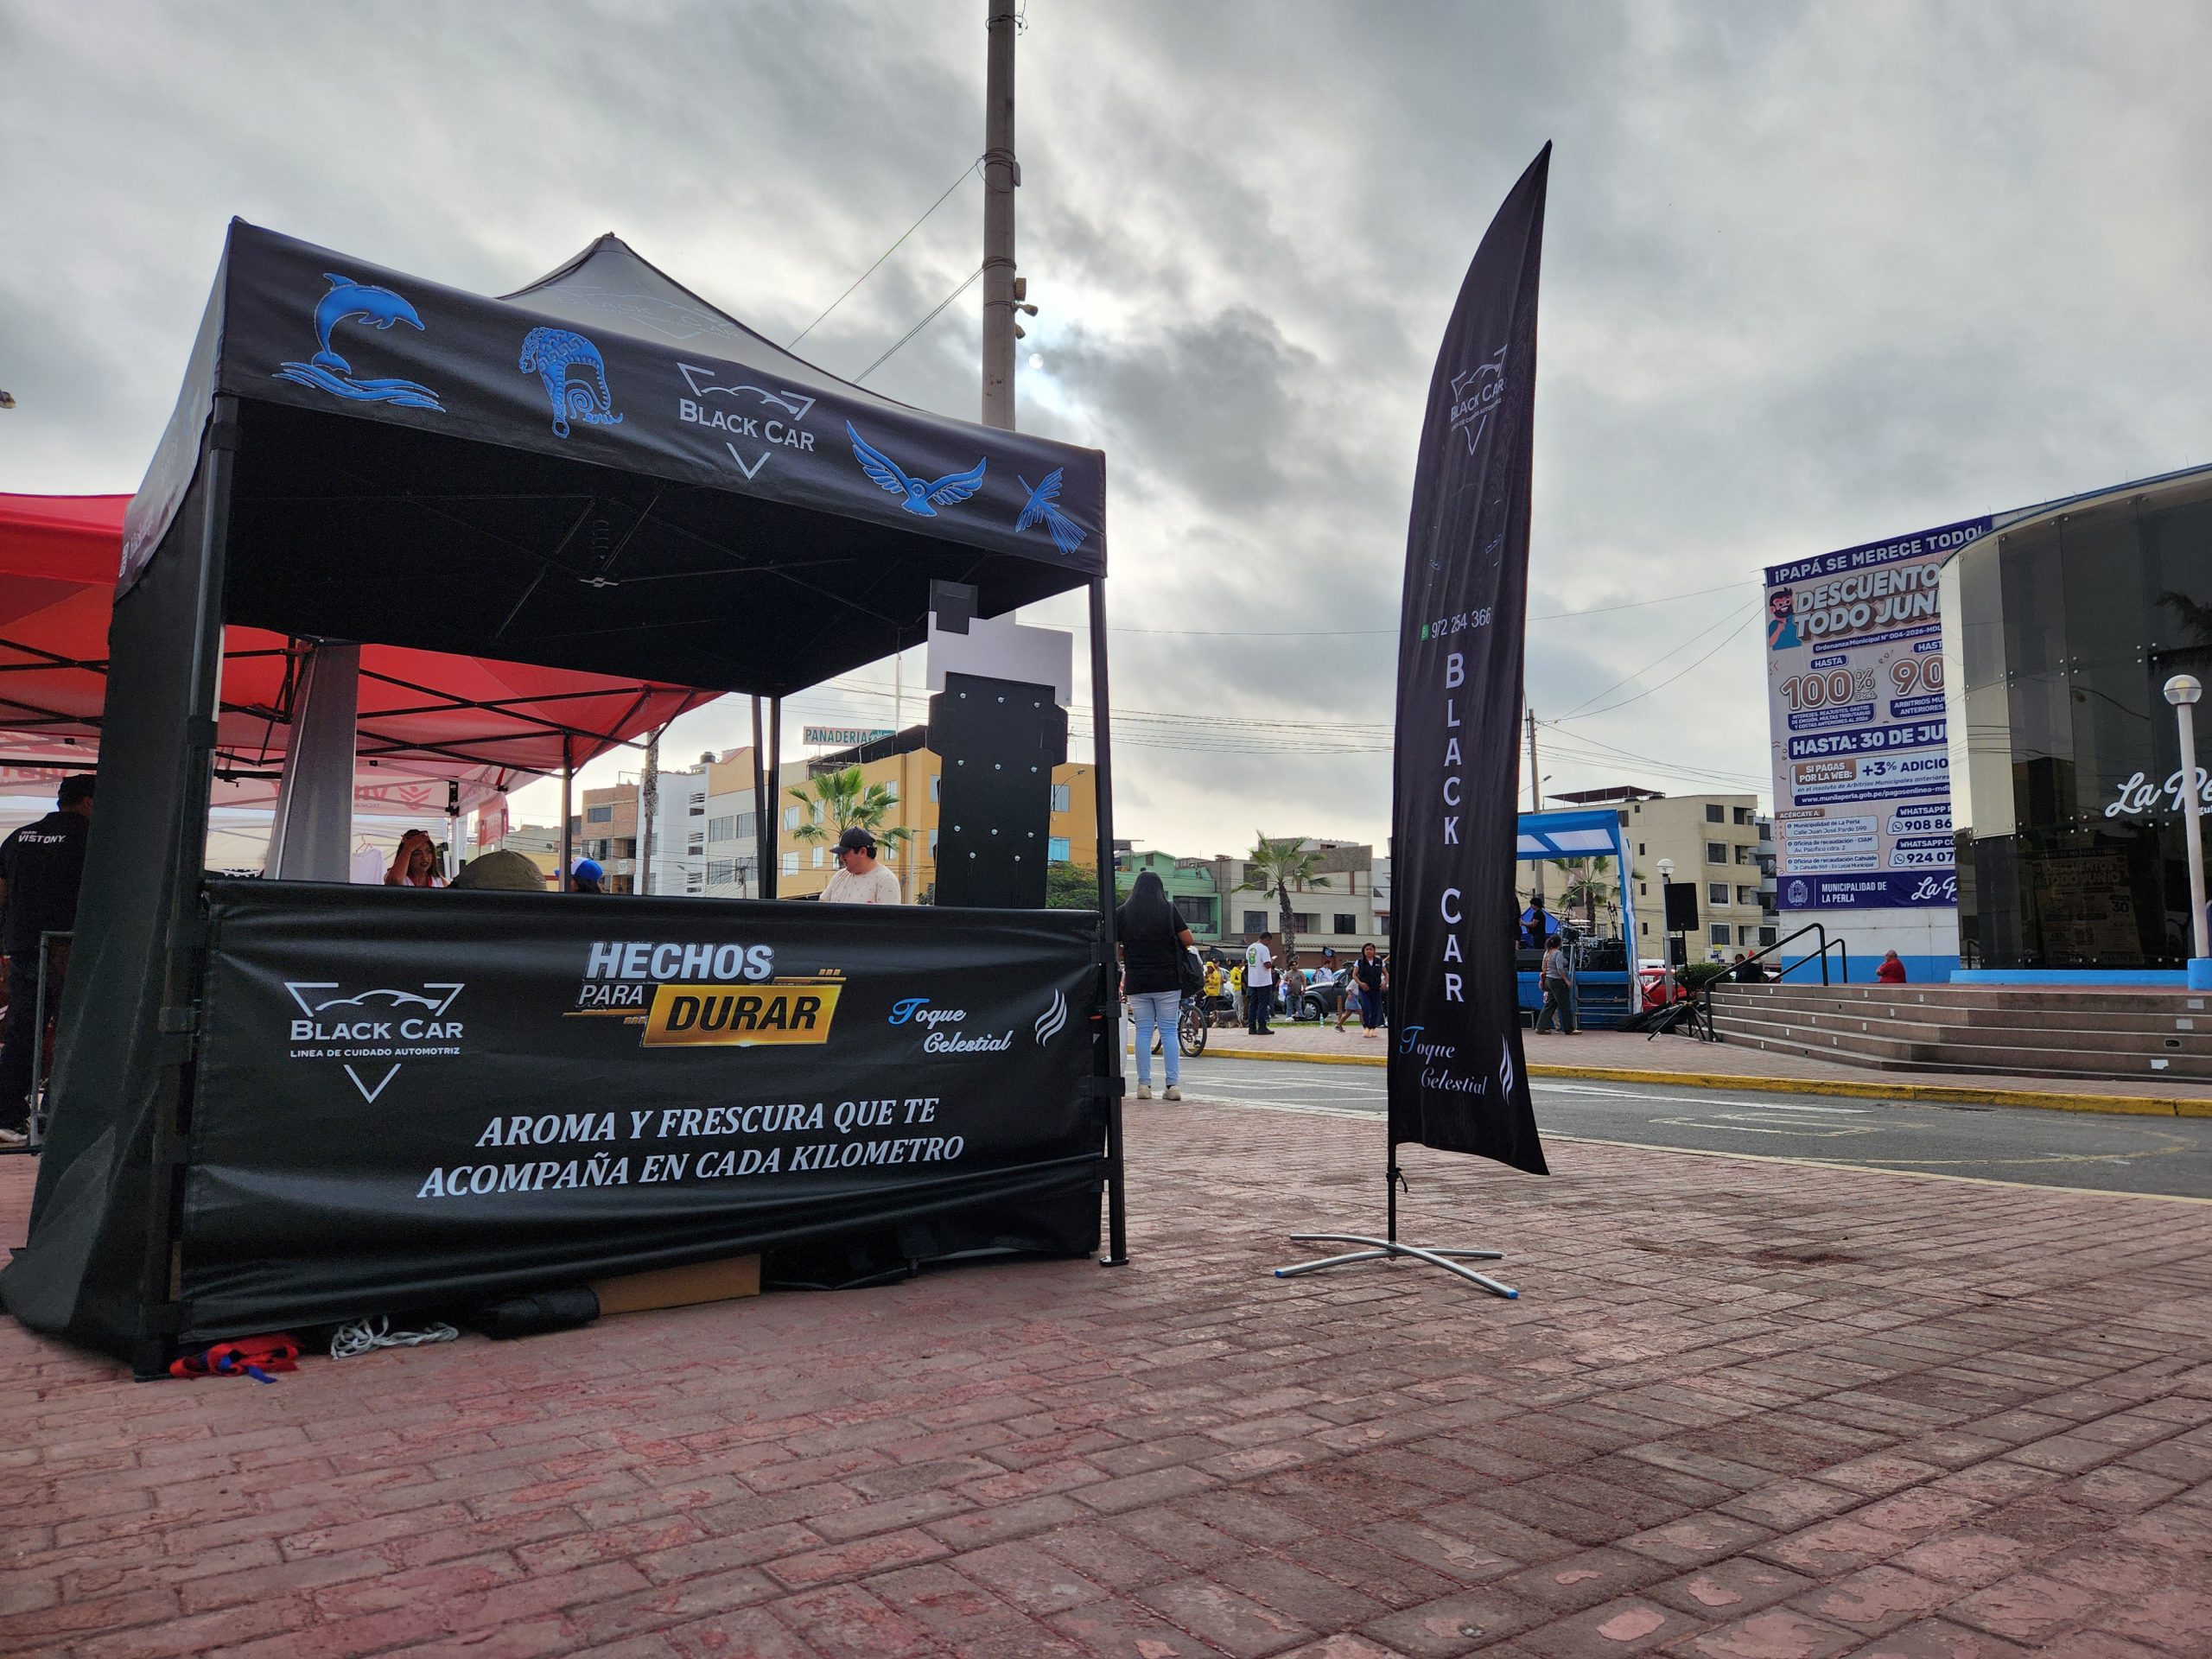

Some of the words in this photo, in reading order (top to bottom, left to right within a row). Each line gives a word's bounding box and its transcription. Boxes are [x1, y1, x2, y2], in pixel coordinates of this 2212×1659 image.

[679, 397, 759, 438] BLACK
[765, 420, 815, 452] CAR
[1826, 557, 1847, 572] SE
[1852, 540, 1923, 567] MERECE
[1431, 619, 1447, 639] 972
[1451, 613, 1467, 634] 254
[1471, 607, 1491, 628] 366
[1795, 602, 1871, 638] TODO
[1815, 641, 1849, 652] Ordenanza
[1849, 636, 1880, 646] Municipal
[1815, 657, 1843, 668] HASTA
[1894, 697, 1931, 709] ARBITRIOS
[1900, 703, 1944, 715] ANTERIORES
[805, 728, 868, 744] PANADERIA
[1793, 734, 1857, 755] HASTA:
[1860, 732, 1885, 748] 30
[1889, 728, 1914, 745] DE
[1443, 652, 1465, 845] BLACK
[1806, 765, 1814, 773] SI
[1815, 762, 1846, 772] PAGAS
[1901, 758, 1948, 772] ADICIO
[1799, 773, 1817, 783] POR
[1818, 772, 1831, 781] LA
[1831, 771, 1853, 780] WEB:
[1875, 778, 1913, 787] Municipales
[2105, 772, 2162, 817] La
[1780, 810, 1813, 819] ACÉRCATE
[1900, 805, 1946, 816] WHATSAPP
[1793, 820, 1829, 829] Municipalidad
[1904, 819, 1931, 830] 908
[18, 835, 67, 844] VISTONY
[1821, 836, 1853, 845] recaudación
[1900, 839, 1943, 849] WHATSAPP
[1906, 852, 1934, 863] 924
[1936, 851, 1955, 862] 07
[1821, 881, 1876, 893] MUNICIPALIDAD
[1878, 881, 1887, 891] DE
[1911, 876, 1942, 900] La
[1821, 894, 1831, 903] LA
[1832, 893, 1855, 903] PERLA
[1440, 887, 1465, 1003] CAR
[585, 943, 773, 980] HECHOS
[578, 984, 645, 1006] PARA
[665, 995, 821, 1032] DURAR
[888, 998, 967, 1030] Toque
[290, 1020, 392, 1041] BLACK
[400, 1019, 464, 1039] CAR
[924, 1030, 1014, 1053] Celestial
[1399, 1025, 1456, 1065] Toque
[290, 1050, 324, 1058] LINEA
[327, 1049, 341, 1058] DE
[344, 1048, 392, 1057] CUIDADO
[394, 1046, 461, 1057] AUTOMOTRIZ
[1421, 1067, 1488, 1096] Celestial
[475, 1112, 616, 1147] AROMA
[629, 1110, 654, 1140] Y
[657, 1103, 824, 1138] FRESCURA
[834, 1100, 897, 1135] QUE
[903, 1097, 939, 1124] TE
[416, 1152, 629, 1198] ACOMPAÑA
[639, 1153, 690, 1184] EN
[696, 1147, 781, 1179] CADA
[788, 1135, 964, 1173] KILOMETRO
